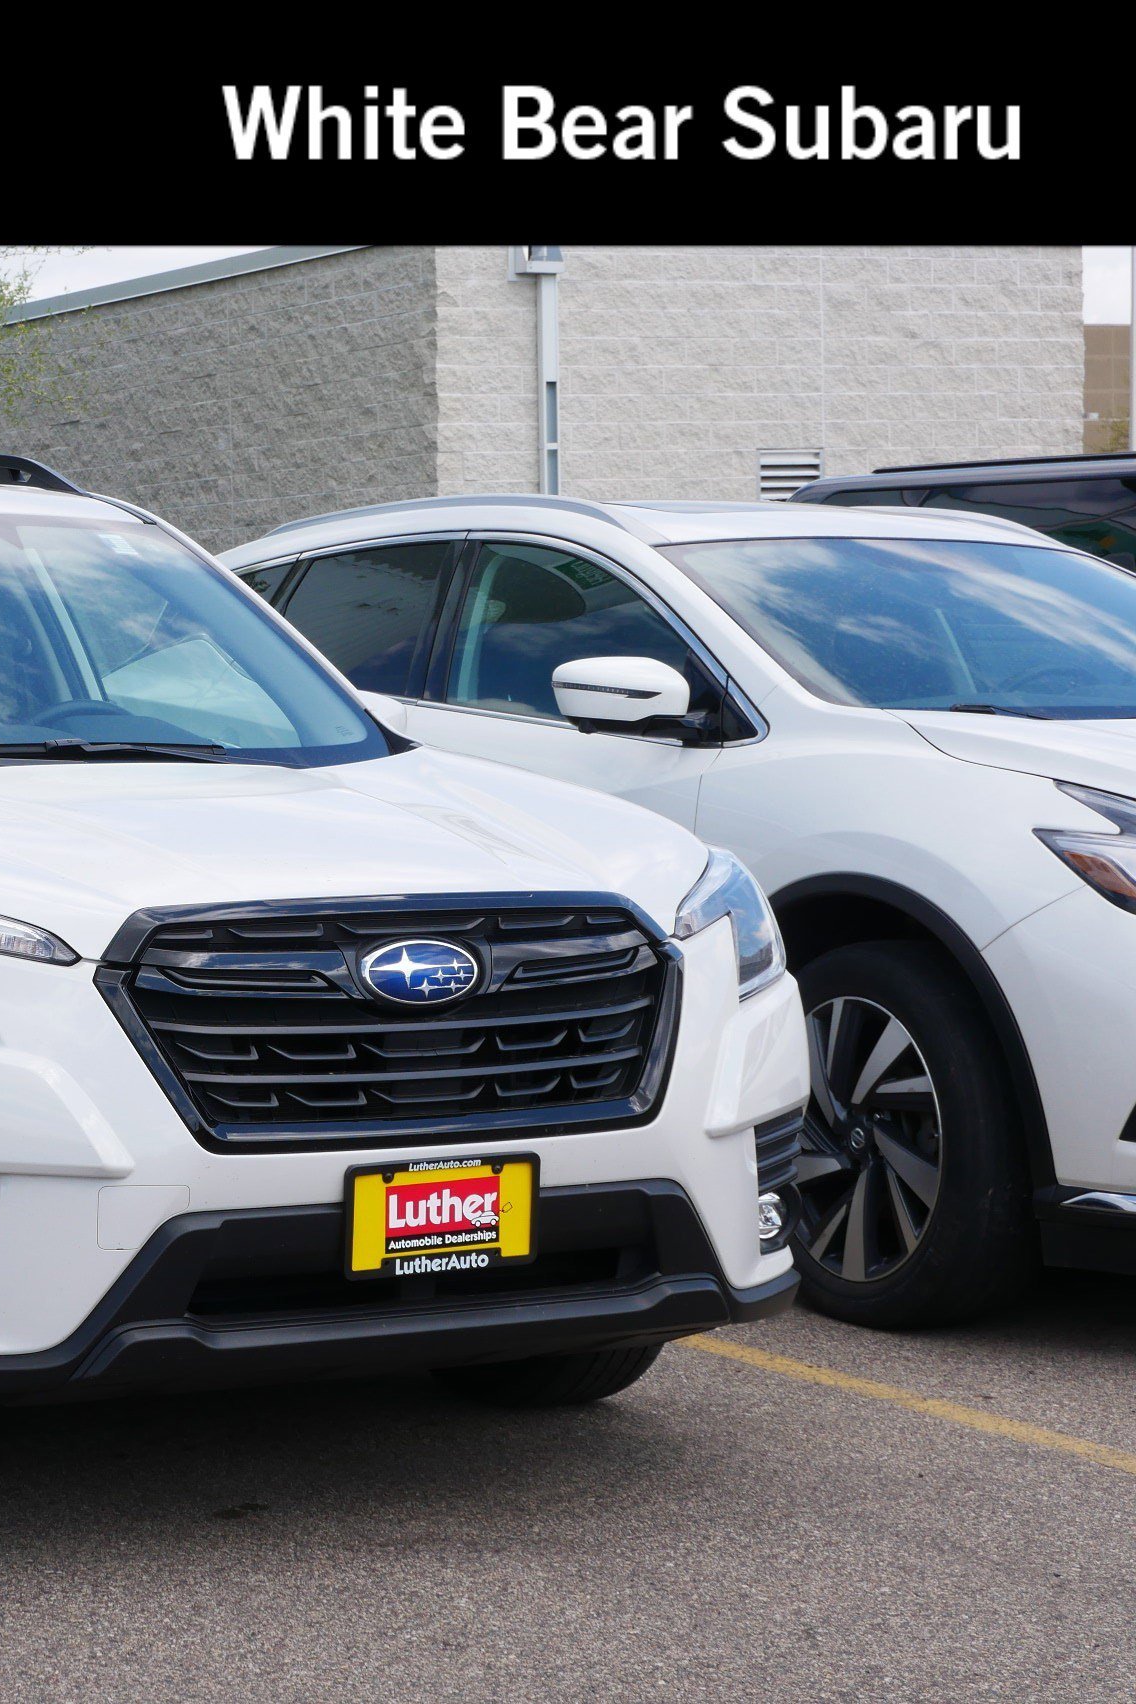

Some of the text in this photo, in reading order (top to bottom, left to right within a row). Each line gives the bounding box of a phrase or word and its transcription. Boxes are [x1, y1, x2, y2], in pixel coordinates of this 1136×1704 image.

[408, 1159, 481, 1172] LutherAuto.com
[388, 1188, 498, 1229] Luther
[388, 1230, 497, 1250] Automobile Dealerships
[395, 1252, 490, 1276] LutherAuto
